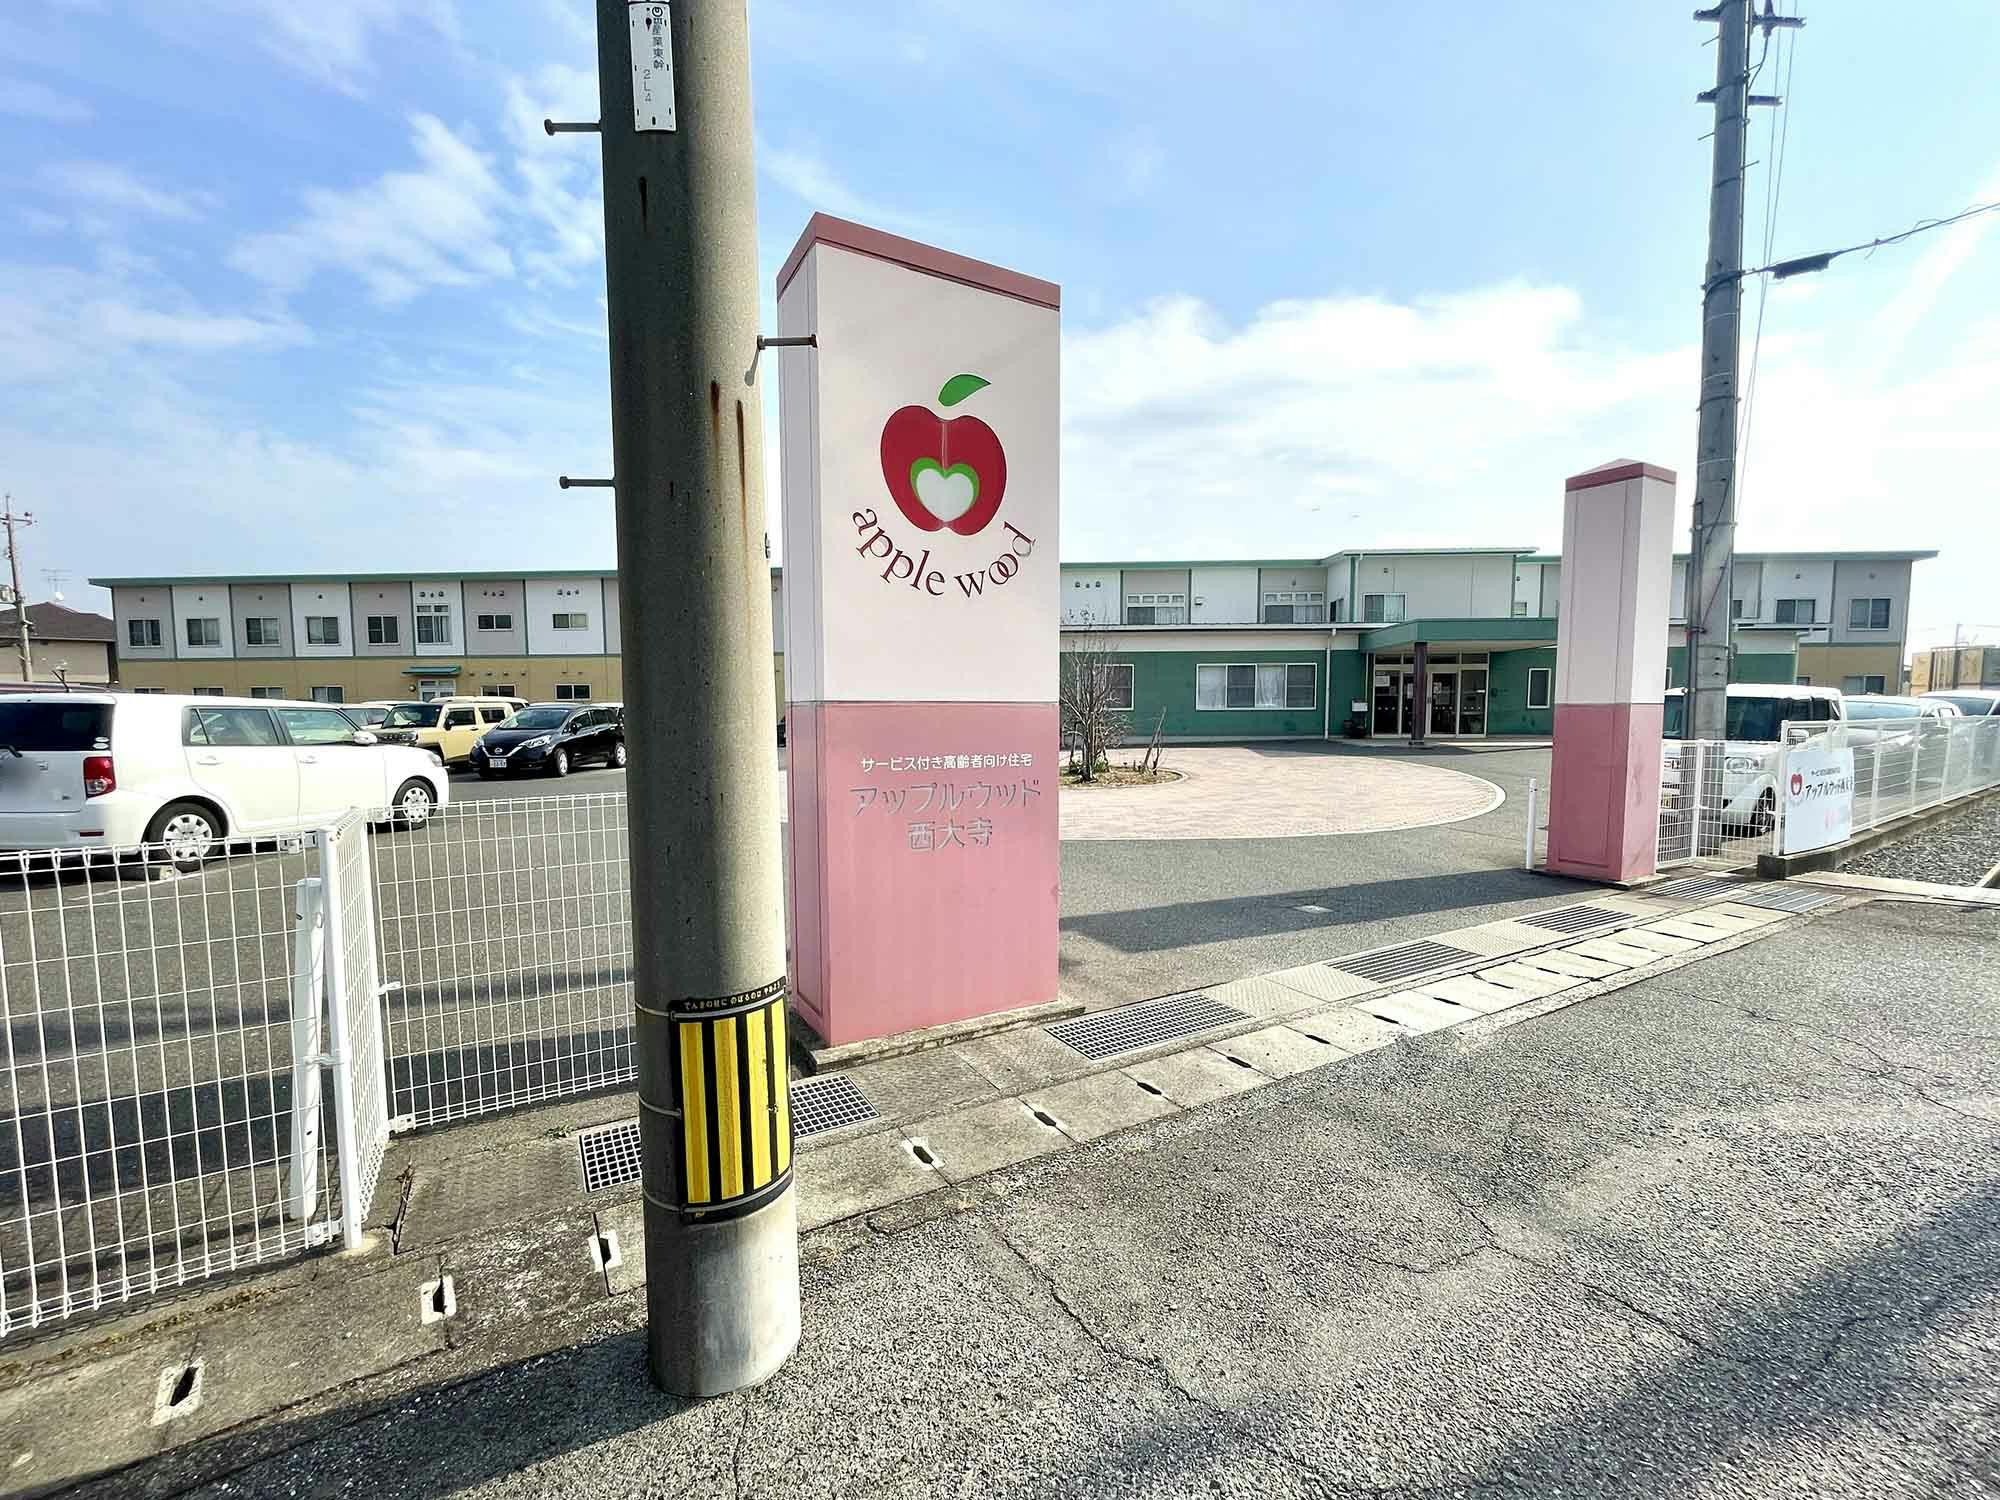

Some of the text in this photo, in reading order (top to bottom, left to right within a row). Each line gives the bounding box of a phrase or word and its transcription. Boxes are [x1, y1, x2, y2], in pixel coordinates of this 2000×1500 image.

[852, 508, 1036, 598] apple wood
[860, 753, 1033, 773] サービス付き高齢者向け住宅
[850, 779, 1041, 816] アップルウッド
[907, 816, 993, 851] 西大寺
